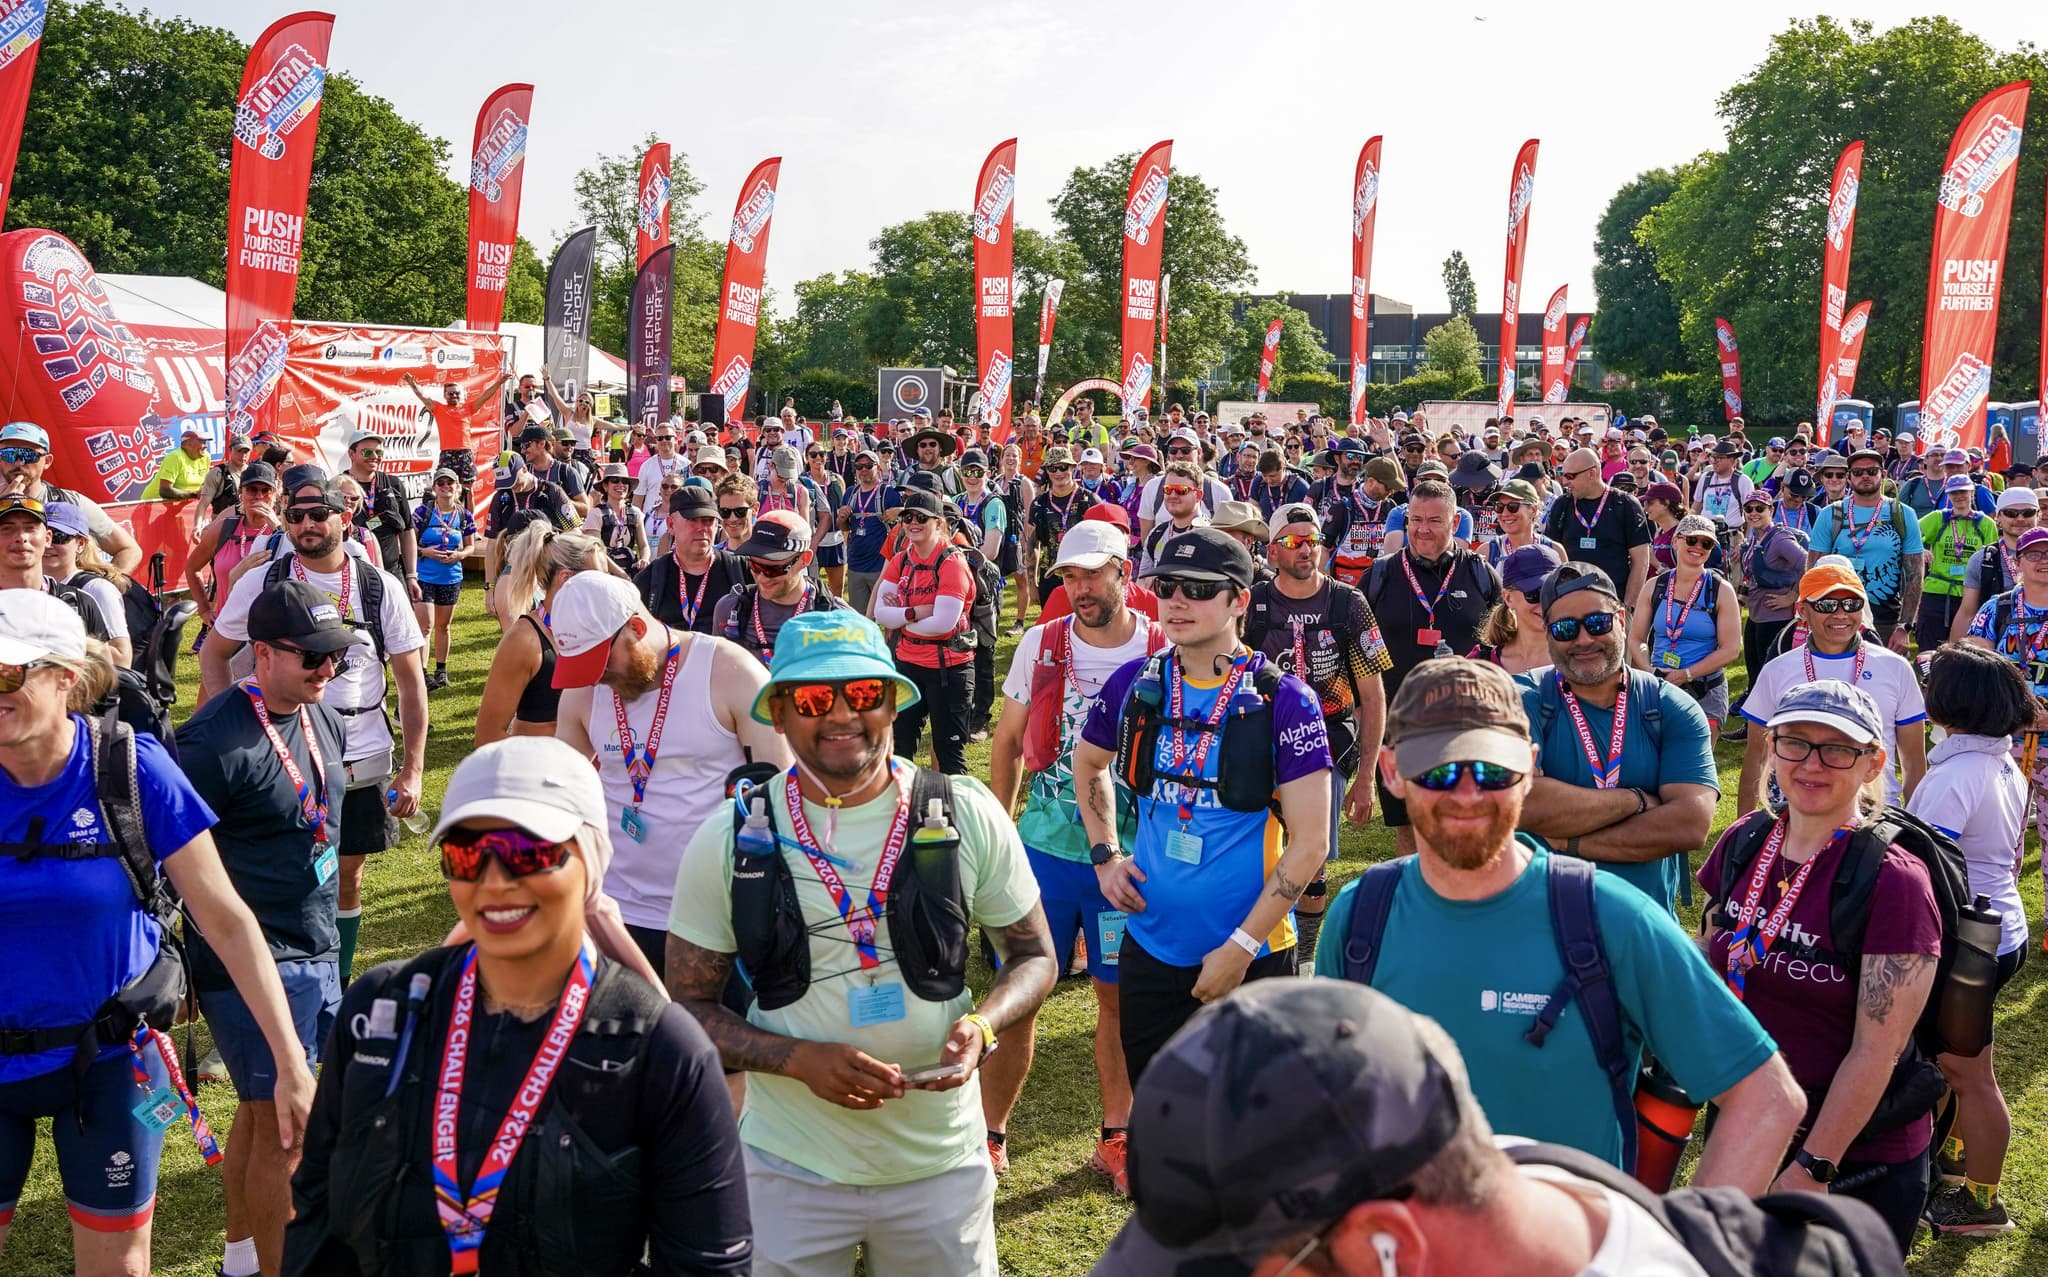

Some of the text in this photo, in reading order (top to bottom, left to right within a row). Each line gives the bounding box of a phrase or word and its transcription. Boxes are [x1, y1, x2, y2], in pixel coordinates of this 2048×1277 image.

[253, 57, 310, 112] ULTRA
[271, 71, 319, 123] CHALLENGE
[1957, 125, 2008, 178] ULTRA
[982, 172, 1009, 214] ULTRA
[1133, 173, 1161, 214] ULTRA
[243, 233, 300, 256] YOURSELF
[244, 206, 302, 242] PUSH
[240, 249, 298, 275] FURTHER
[1944, 260, 1998, 282] PUSH
[729, 282, 760, 306] PUSH
[982, 278, 1008, 294] PUSH
[1129, 279, 1156, 297] PUSH
[1940, 296, 1994, 311] FURTHER
[1943, 283, 1995, 296] YOURSELF
[563, 279, 573, 358] SCIENCE
[645, 293, 654, 367] SCIENCE
[229, 334, 279, 390] ULTRA
[983, 361, 1006, 397] ULTRA
[1931, 362, 1978, 414] ULTRA
[356, 404, 417, 434] LONDON
[1287, 614, 1321, 624] ANDY
[1312, 649, 1332, 657] GREAT
[1313, 660, 1336, 670] STREET
[648, 660, 677, 751] 2026 CHALLENGER
[1172, 664, 1183, 759] 2026 HALLENGER
[1195, 667, 1241, 760] 2026 CHALLNGER
[618, 722, 632, 749] 2026
[1118, 716, 1130, 776] KARRIMOR
[1280, 716, 1326, 746] Alzhei
[1564, 691, 1598, 764] 26 CHALLENGER
[1612, 728, 1622, 754] 2026
[283, 758, 303, 785] 2026
[68, 827, 99, 838] TEAM GB
[874, 803, 910, 892] CHALLENGER
[815, 854, 842, 895] 2026
[1742, 818, 1786, 924] 2026 CHALLENGER
[1763, 862, 1812, 938] CHALLENGER
[437, 973, 475, 1162] 2026 CHALLENGER
[492, 982, 588, 1164] 2026 CHALLENGER
